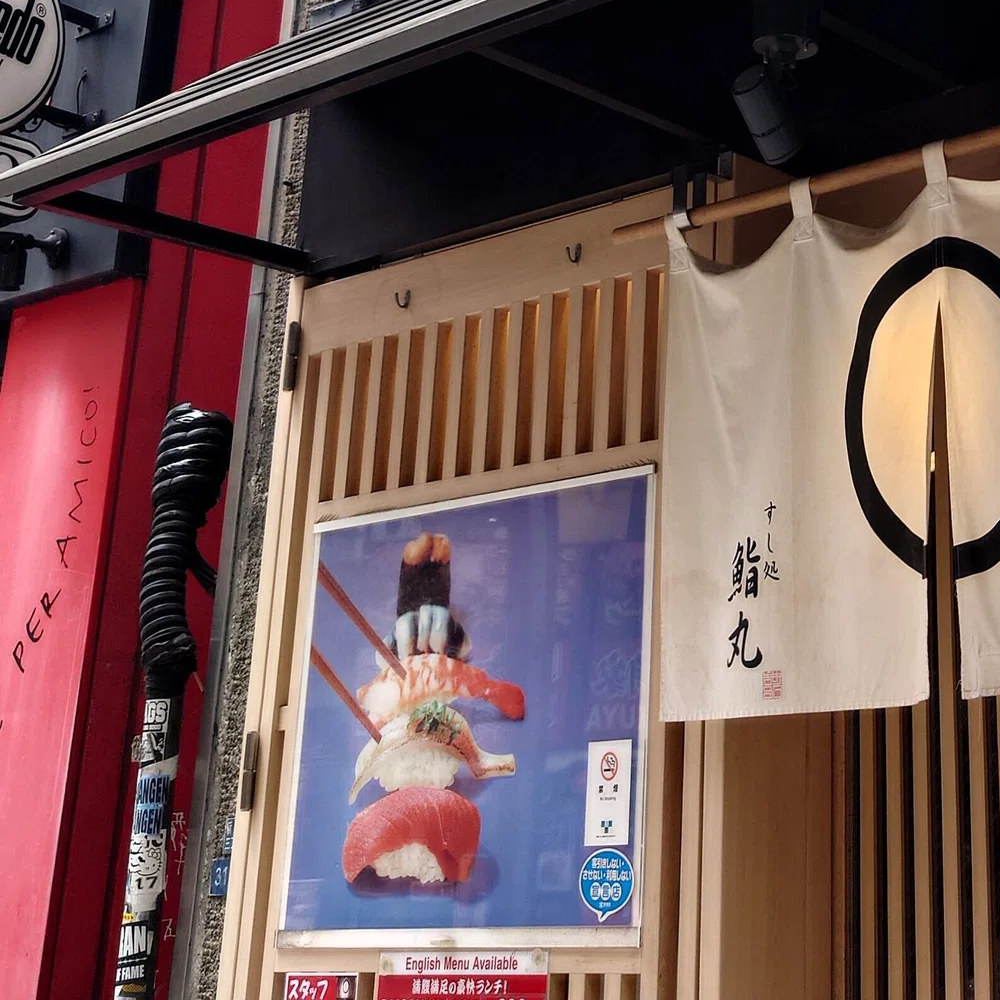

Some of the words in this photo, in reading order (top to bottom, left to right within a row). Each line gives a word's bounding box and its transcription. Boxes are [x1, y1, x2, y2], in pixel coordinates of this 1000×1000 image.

[764, 501, 780, 581] すし処
[12, 589, 61, 674] PER
[727, 537, 763, 669] 鮨丸
[288, 979, 329, 1000] スタッフ
[405, 957, 441, 974] English
[443, 956, 470, 971] Menu
[472, 955, 518, 970] Available
